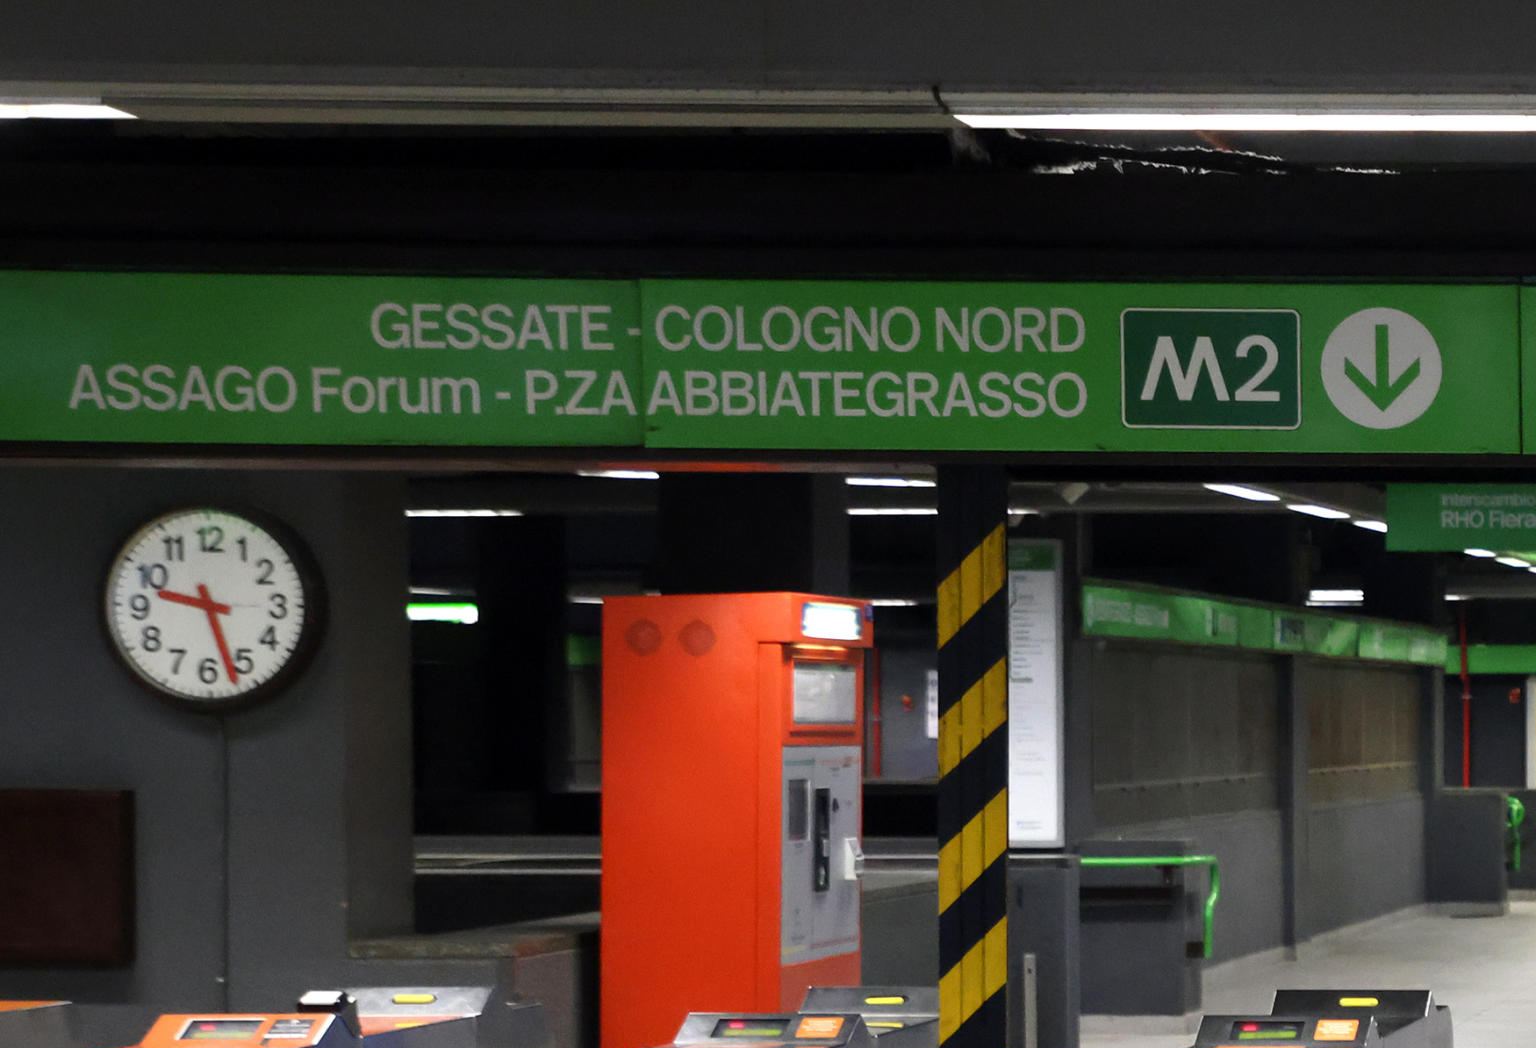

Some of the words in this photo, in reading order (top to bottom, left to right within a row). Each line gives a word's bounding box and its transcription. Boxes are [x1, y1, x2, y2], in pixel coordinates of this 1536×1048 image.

[371, 303, 613, 351] GESSATE
[655, 305, 921, 352] COLOGNO
[936, 307, 1086, 353] NORD
[1140, 335, 1280, 401] M2
[68, 364, 297, 413] ASSAGO
[312, 367, 481, 414] Forum
[526, 370, 637, 416] P.ZA
[647, 371, 1088, 418] ABBIATEGRASSO
[1441, 511, 1484, 529] RHO
[162, 536, 184, 561] 11
[197, 526, 224, 553] 12
[236, 537, 247, 562] 1
[137, 563, 168, 590] 10
[256, 559, 274, 585] 2
[130, 594, 149, 620] 9
[269, 593, 287, 619] 3
[142, 626, 160, 652] 8
[259, 626, 279, 650] 4
[169, 649, 187, 675] 7
[198, 658, 218, 684] 6
[234, 649, 253, 674] 5
